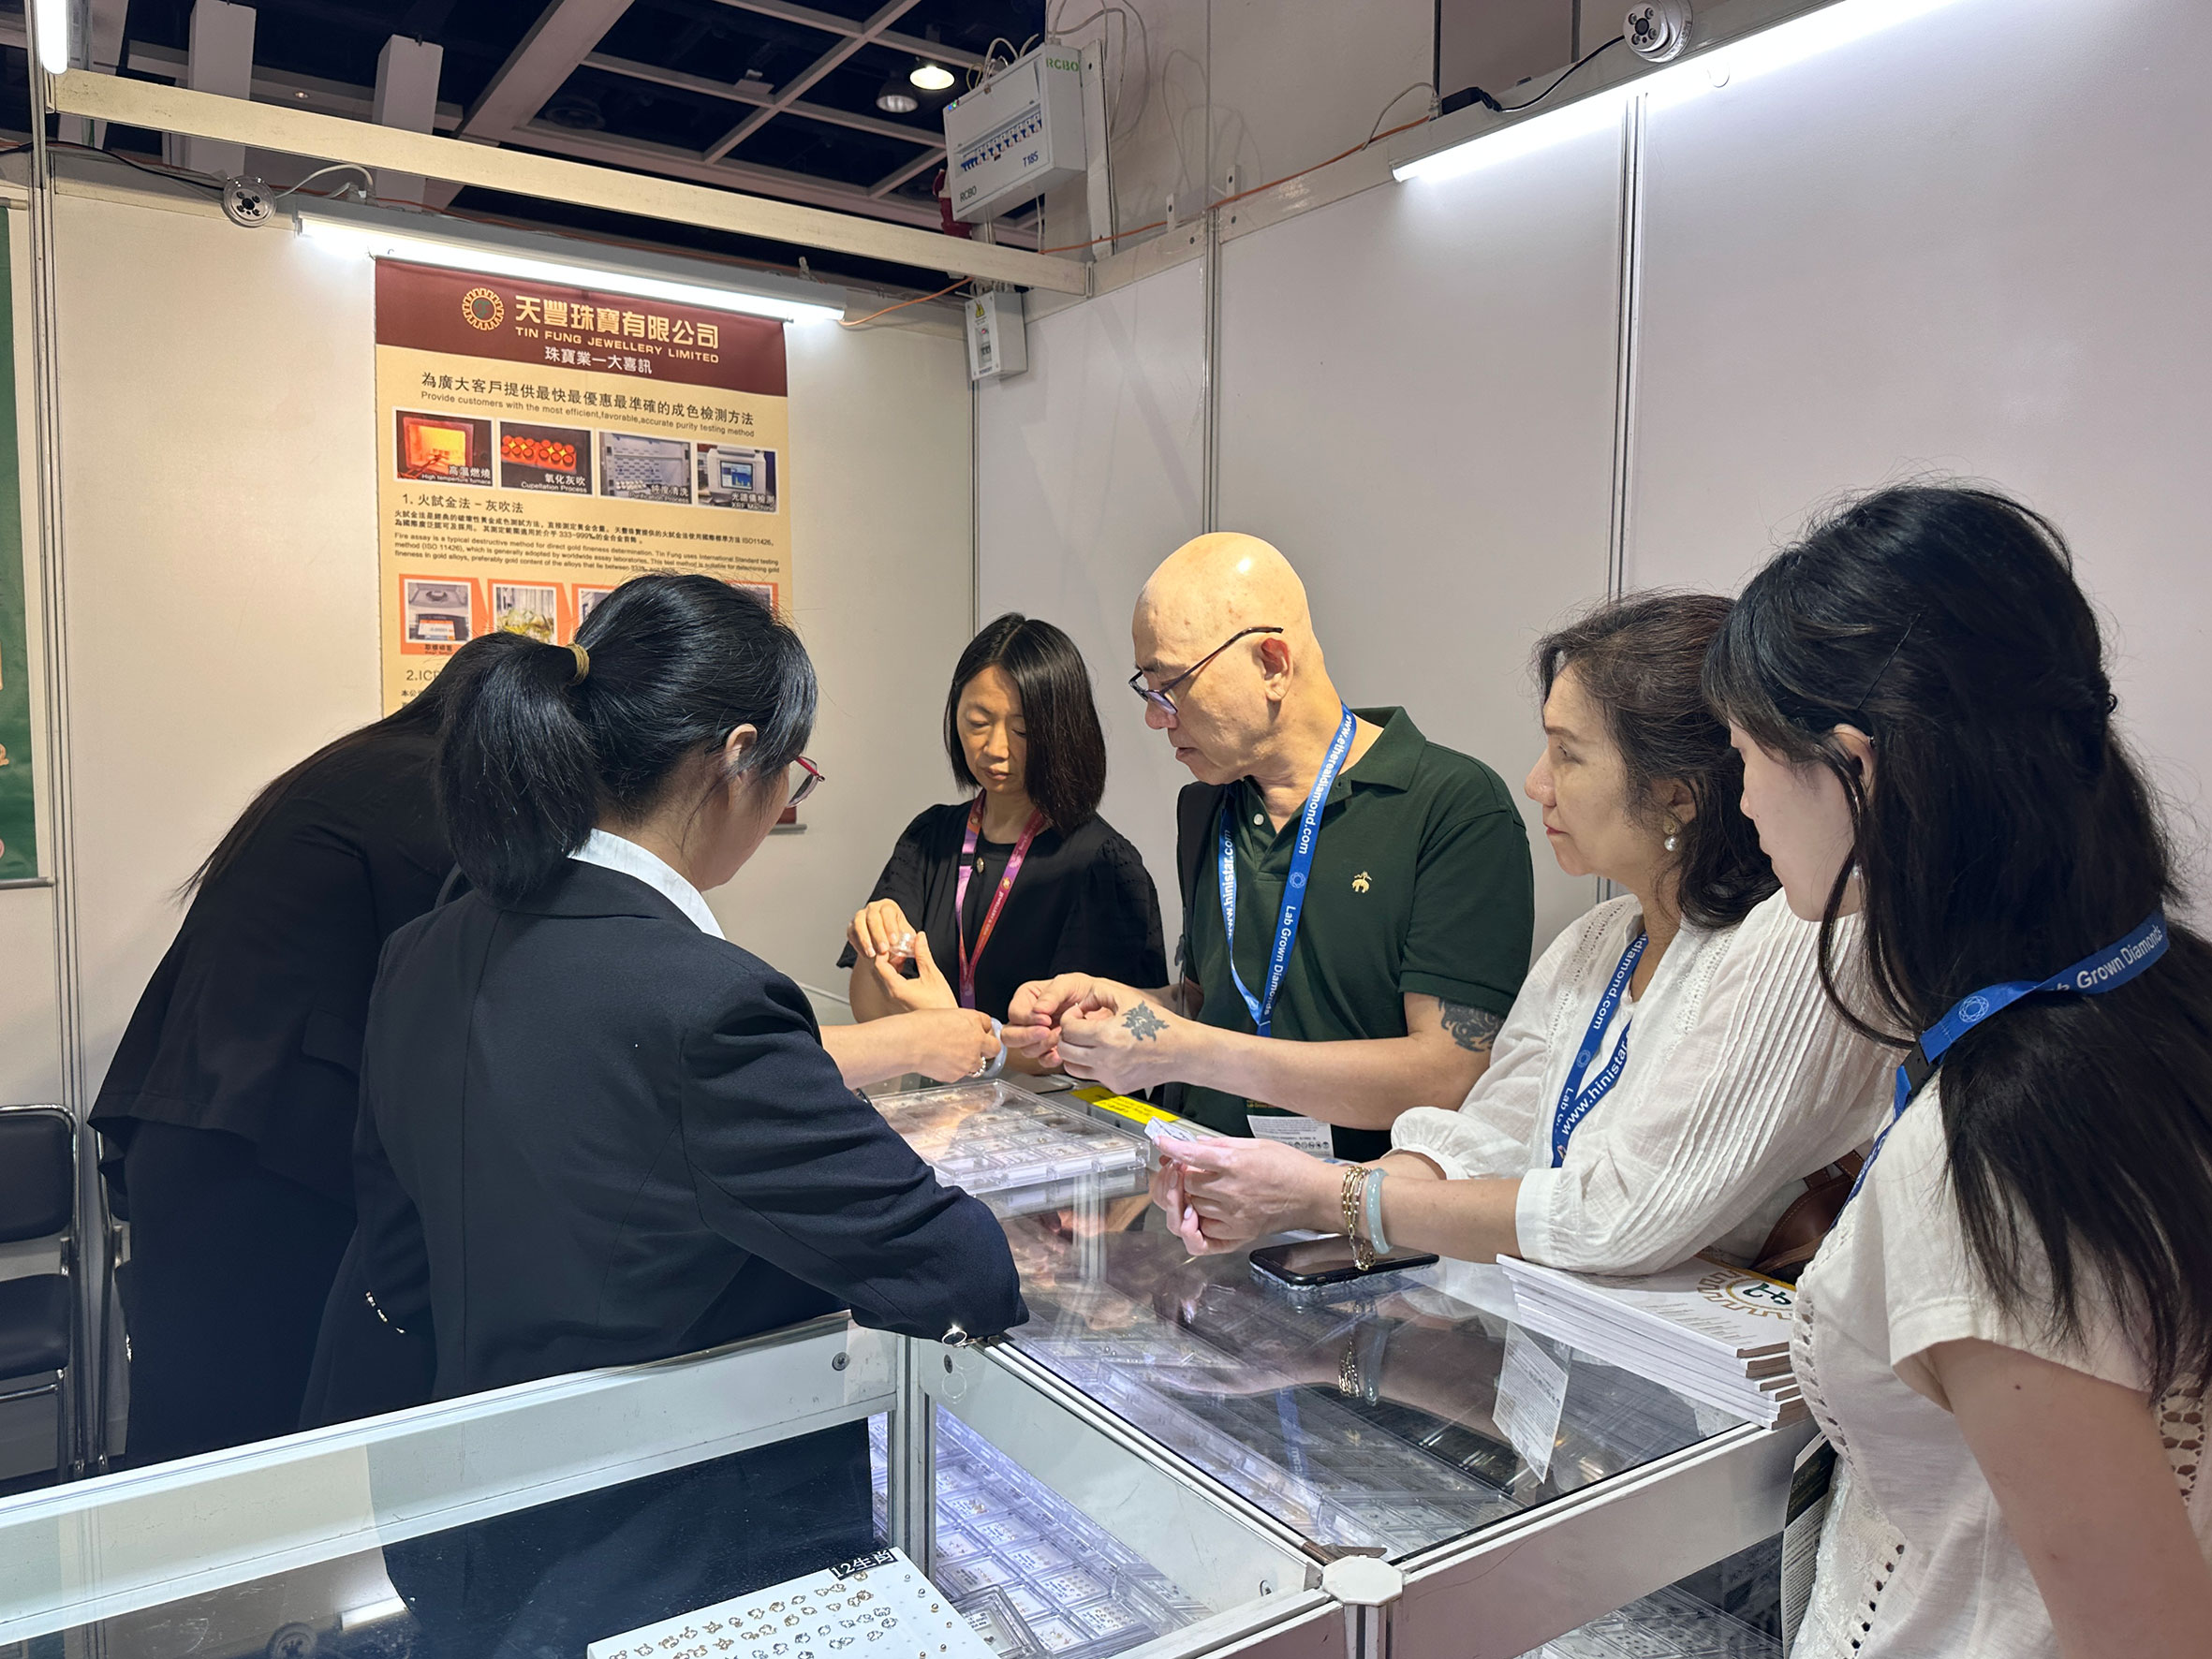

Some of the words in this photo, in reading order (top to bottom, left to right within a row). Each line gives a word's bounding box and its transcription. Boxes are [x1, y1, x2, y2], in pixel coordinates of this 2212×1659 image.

[1046, 58, 1080, 72] RCBO
[959, 185, 978, 203] RCBO
[515, 295, 719, 349] 天豐珠寶有限公司
[515, 326, 539, 339] TIN
[545, 330, 582, 345] FUNG
[588, 337, 662, 355] JEWELLERY
[668, 348, 719, 363] LIMITED
[545, 345, 653, 374] 珠寶業一大喜訊
[421, 390, 455, 404] Provide
[458, 396, 504, 408] customers
[506, 401, 524, 410] with
[526, 403, 540, 412] the
[542, 405, 564, 415] most
[676, 421, 698, 432] purity
[700, 425, 725, 434] testing
[727, 427, 755, 437] method
[560, 485, 587, 493] Process
[403, 493, 413, 505] 1.
[418, 494, 470, 509] 火試金法
[485, 499, 524, 514] 灰吹法
[472, 537, 508, 546] destructive
[667, 551, 682, 559] Fung
[472, 555, 503, 564] preferably
[1284, 905, 1296, 927] Lab
[1276, 927, 1292, 962] Grown
[2076, 957, 2126, 989] Grown
[1263, 964, 1285, 1016] Diamonds
[1560, 1088, 1574, 1110] Lab
[831, 1549, 895, 1578] 12生肖
